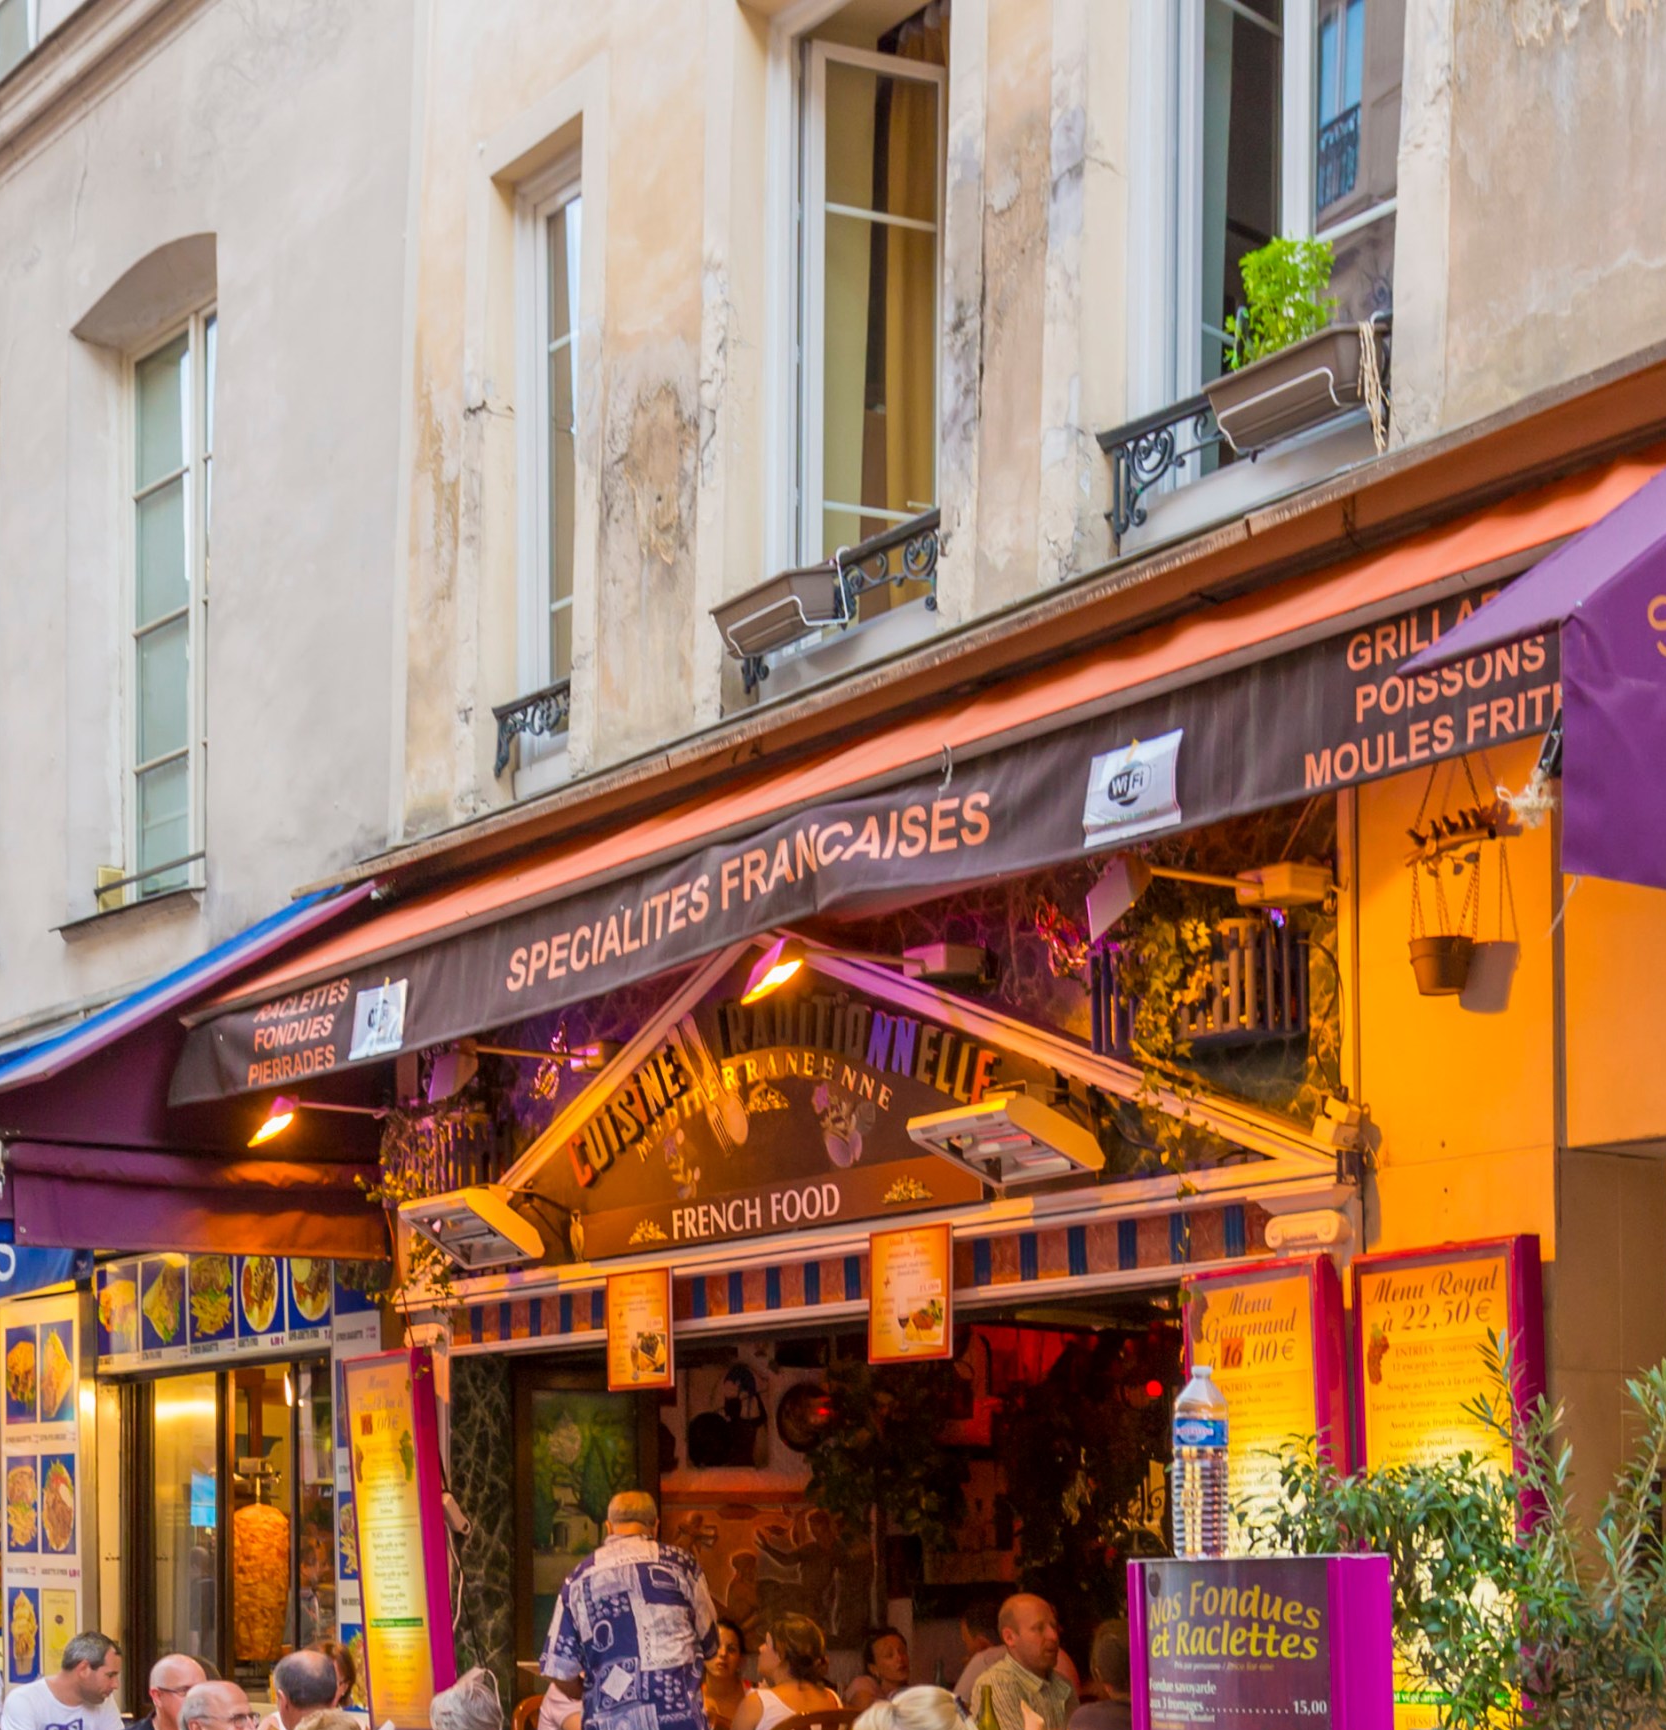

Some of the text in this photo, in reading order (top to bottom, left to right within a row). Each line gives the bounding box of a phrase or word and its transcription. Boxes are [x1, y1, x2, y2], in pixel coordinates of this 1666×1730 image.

[1355, 635, 1547, 724] POISSONS
[1304, 714, 1456, 790] MOULES
[505, 873, 710, 993] SPECIALITES
[253, 977, 351, 1024] RACLETTES
[254, 1013, 335, 1053] FONDUES
[247, 1044, 336, 1088] PIERRADES
[565, 1042, 689, 1189] CUISINE
[670, 1184, 842, 1241] FRENCH FOOD
[1221, 1291, 1274, 1317] Menu
[1366, 1264, 1499, 1306] Menu Royal
[1205, 1307, 1298, 1346] Gourmand
[1382, 1310, 1394, 1333] à
[1387, 1381, 1412, 1393] Soupe
[1389, 1438, 1413, 1449] Salade
[1427, 1436, 1453, 1448] poulet
[1149, 1580, 1322, 1631] Nos Fondues
[1151, 1620, 1320, 1661] et Raclettes
[1292, 1700, 1328, 1715] 15,00
